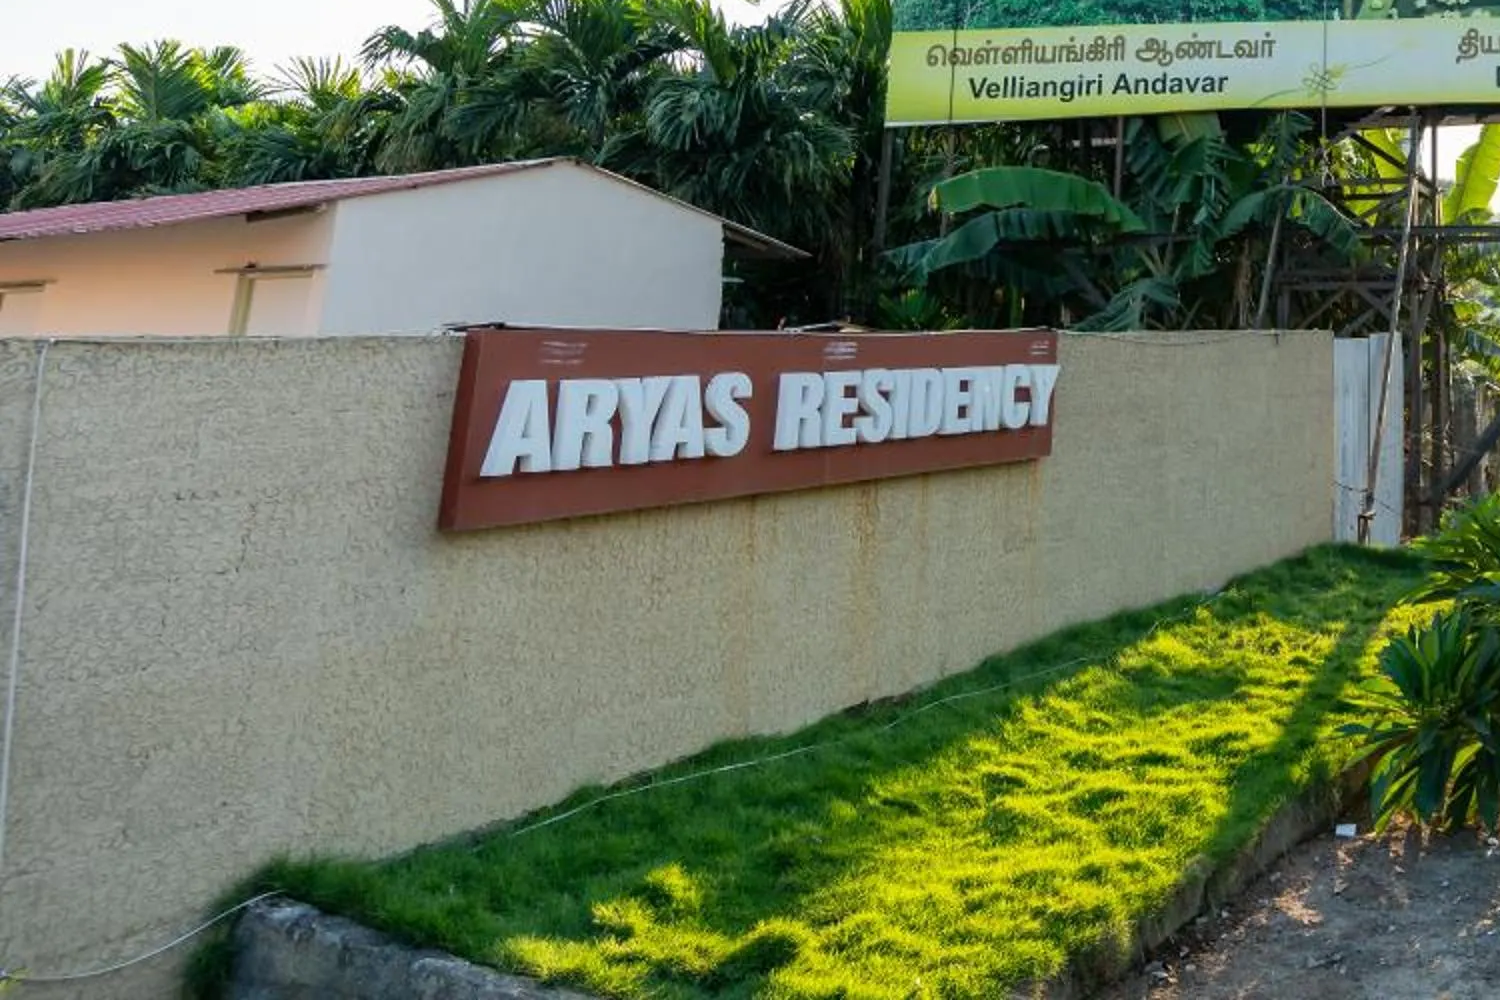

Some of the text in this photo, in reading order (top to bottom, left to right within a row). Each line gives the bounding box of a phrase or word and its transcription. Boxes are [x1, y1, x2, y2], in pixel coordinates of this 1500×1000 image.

[926, 31, 1276, 67] வெள்ளியங்கிரி ஆண்டவர்
[969, 71, 1229, 102] Velliangiri Andavar
[479, 362, 1061, 477] ARYAS RESIDENCY
